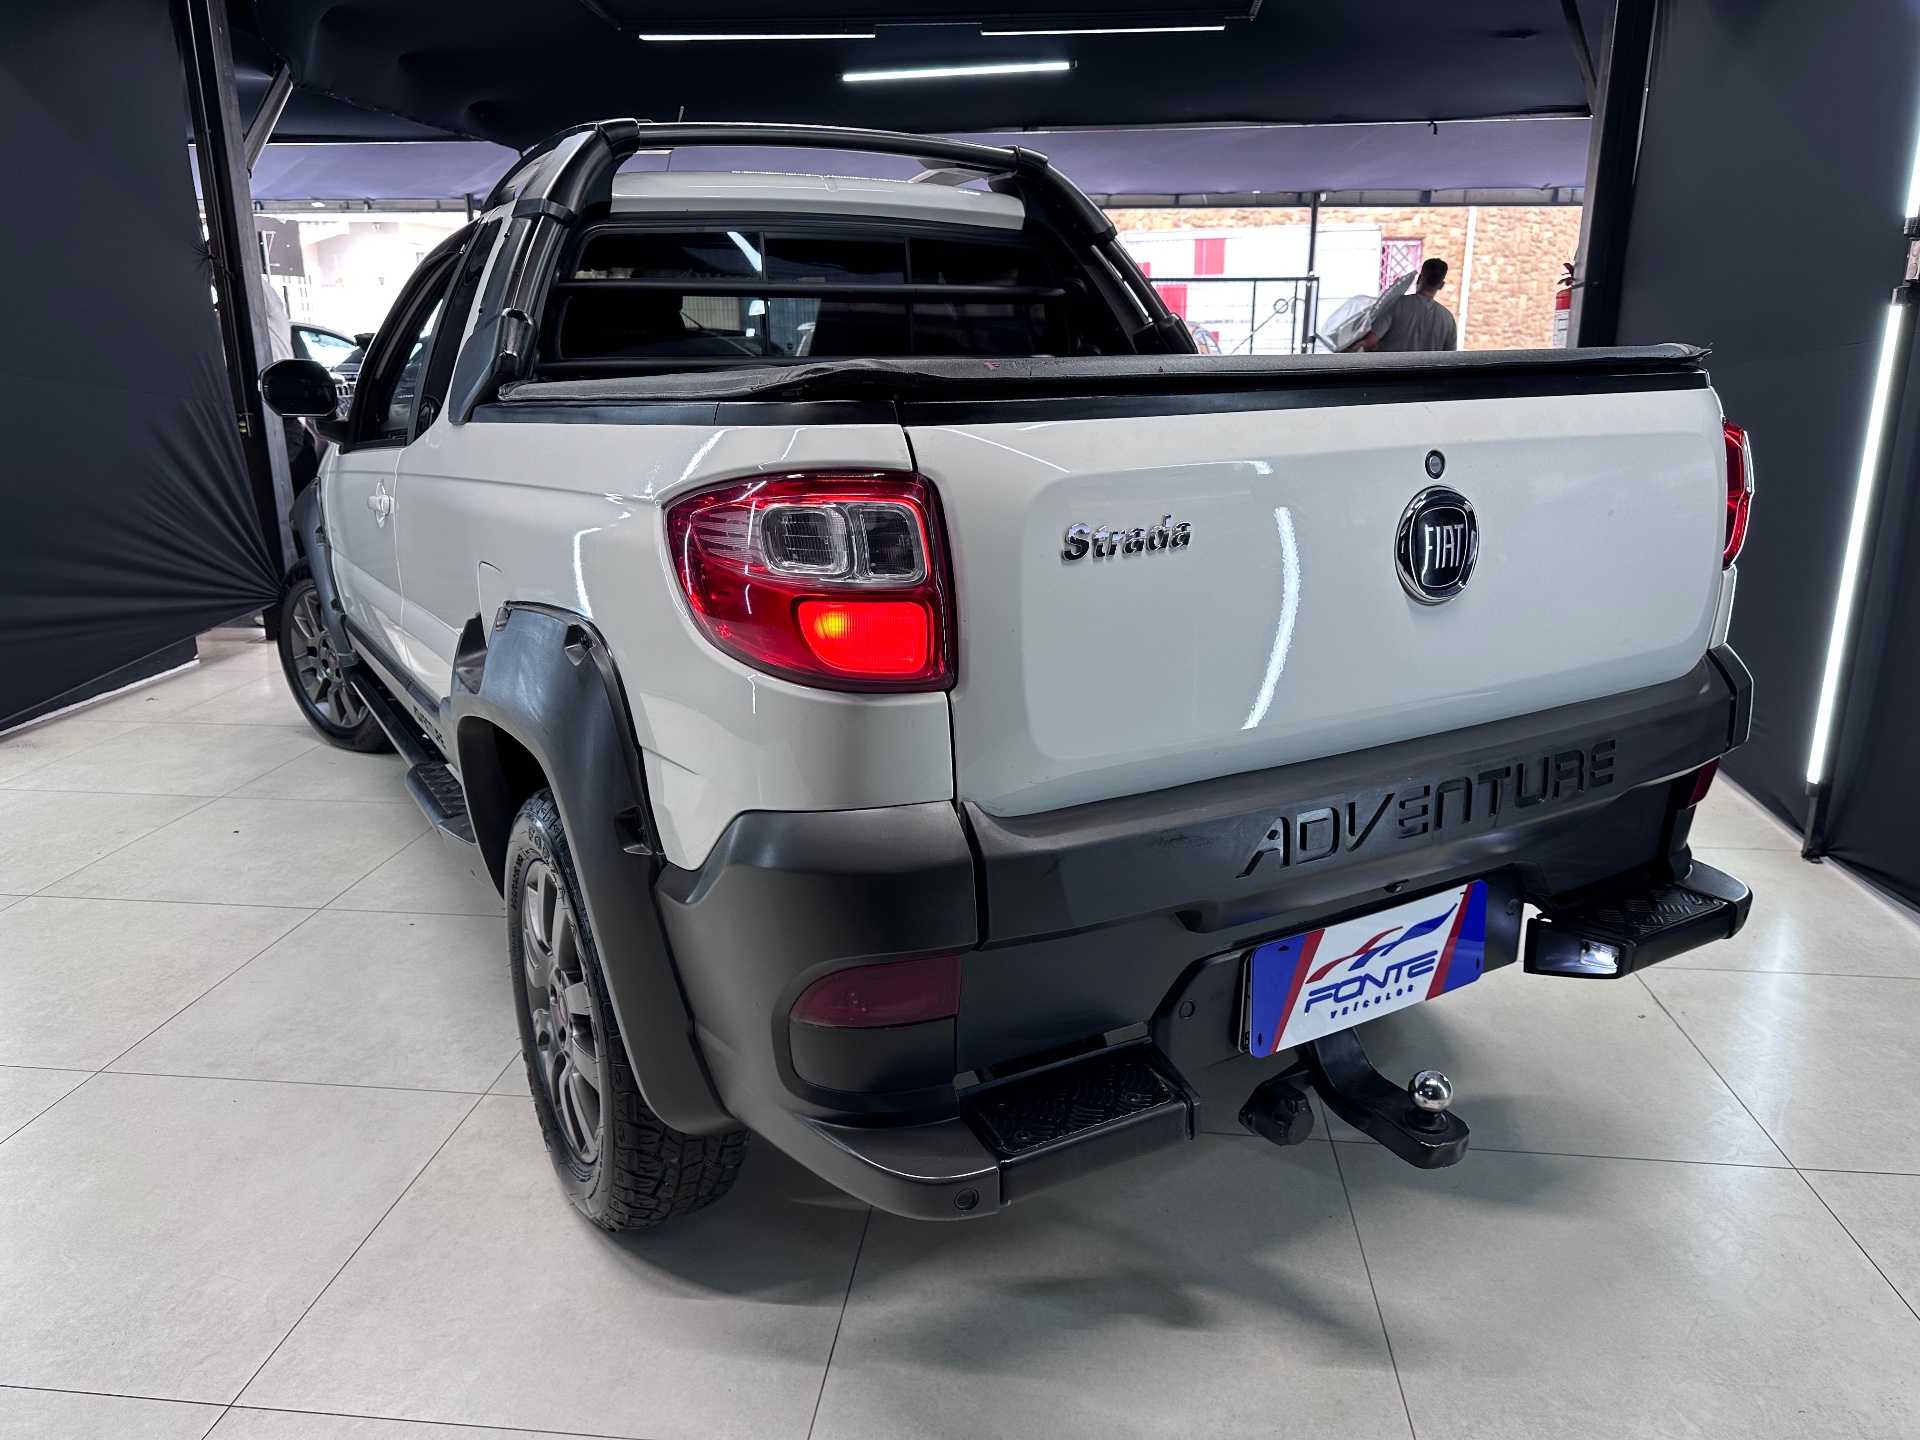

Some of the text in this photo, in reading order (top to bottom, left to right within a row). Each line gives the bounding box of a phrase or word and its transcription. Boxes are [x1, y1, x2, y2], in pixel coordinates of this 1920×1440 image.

[1061, 514, 1193, 561] Strada
[1424, 523, 1465, 570] FIAT
[1236, 739, 1617, 879] ADVENTURE
[1304, 949, 1439, 1014] FONTE
[1330, 984, 1414, 1019] VEICULOS
